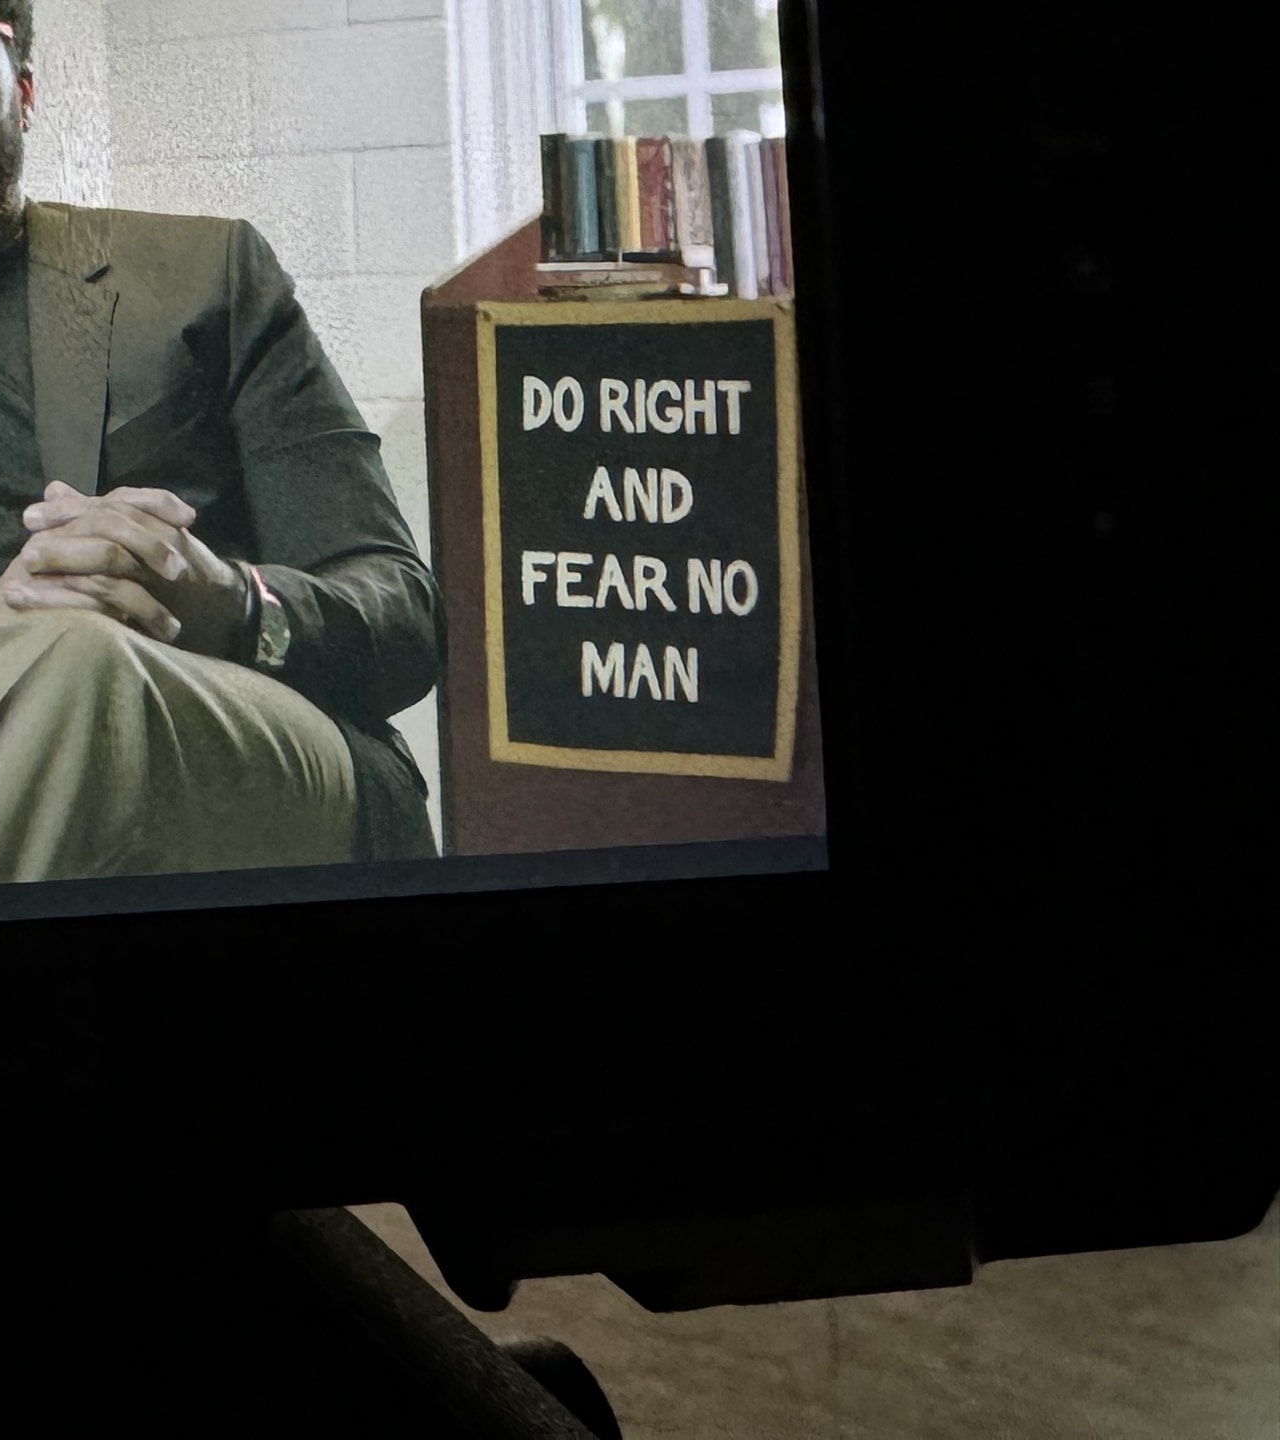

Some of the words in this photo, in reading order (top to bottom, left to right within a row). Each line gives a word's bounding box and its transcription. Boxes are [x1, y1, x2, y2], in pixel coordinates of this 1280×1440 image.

[522, 375, 584, 432] DO
[600, 377, 752, 435] RIGHT
[583, 466, 693, 524] AND
[521, 551, 677, 612] FEAR
[688, 558, 759, 616] NO
[581, 640, 699, 703] MAN
